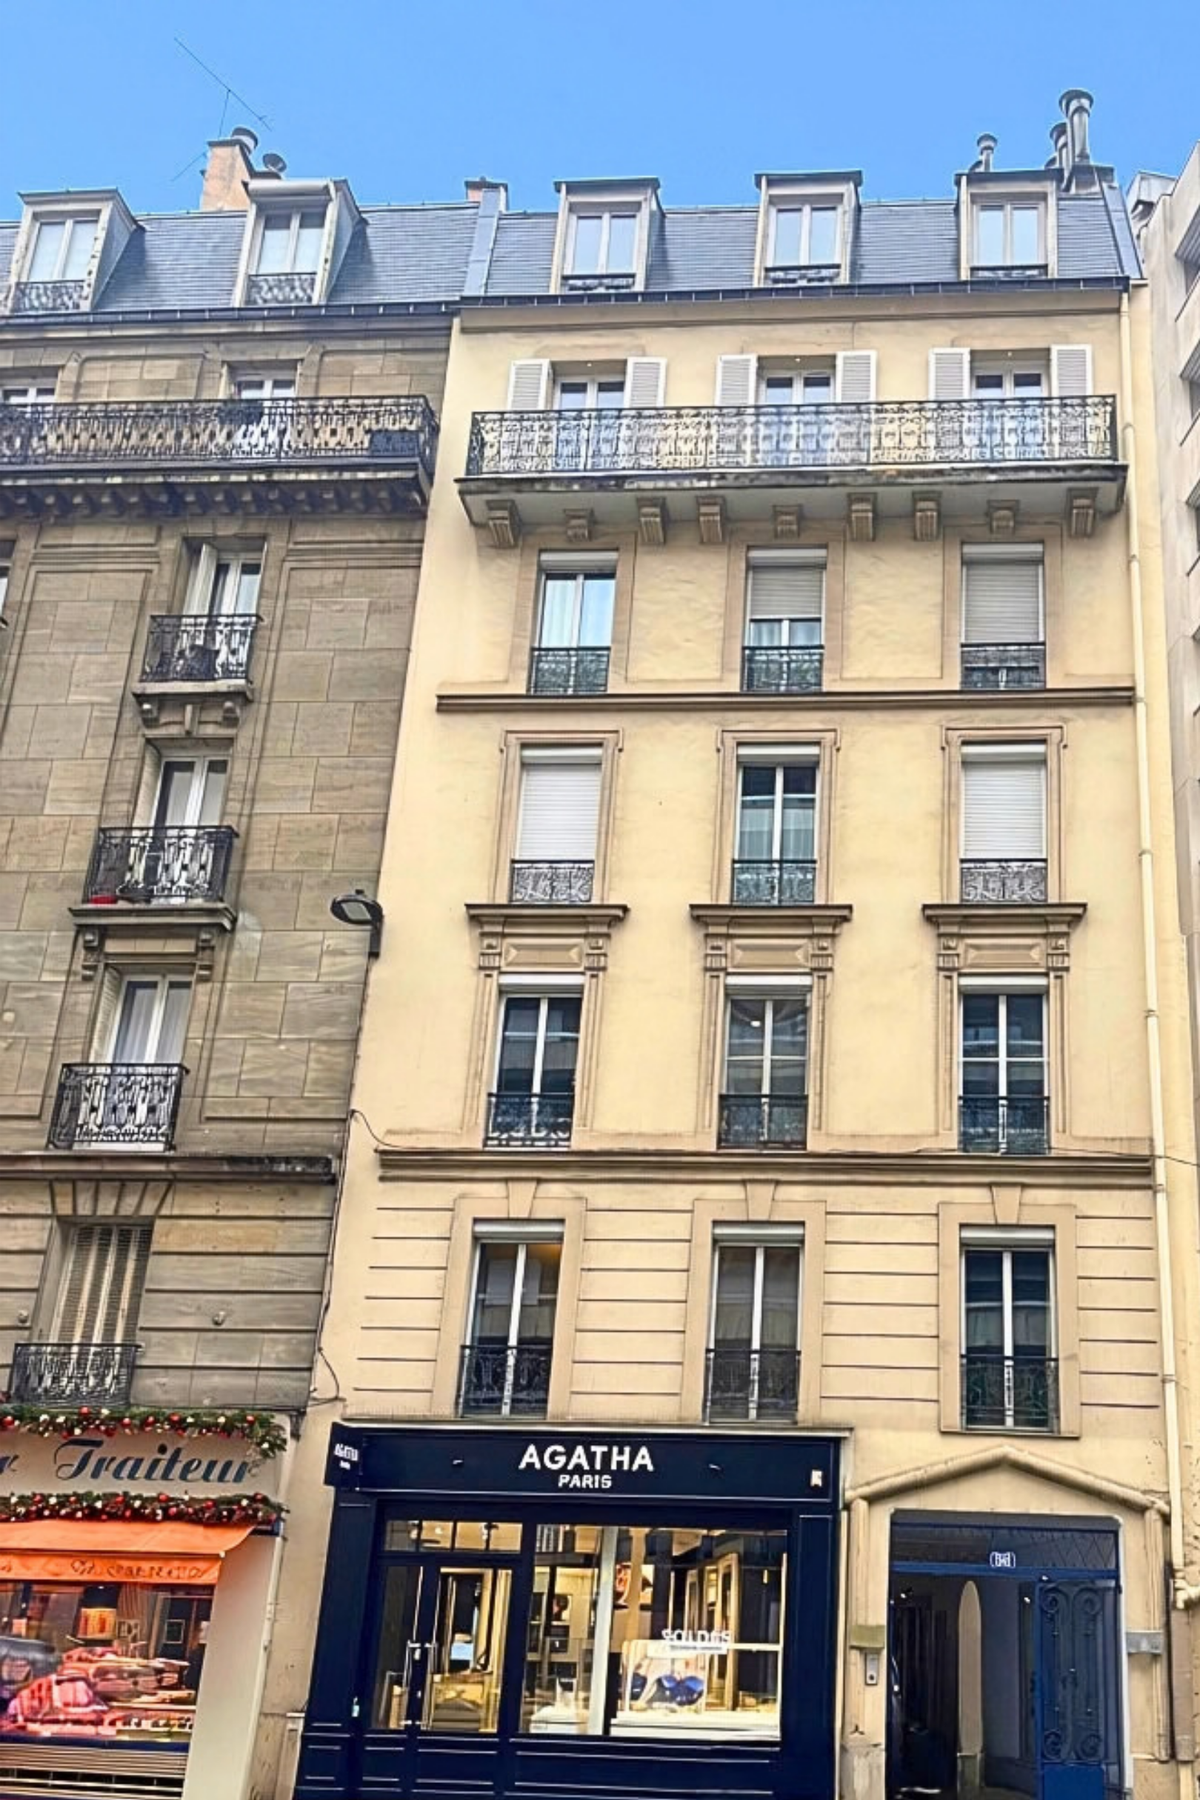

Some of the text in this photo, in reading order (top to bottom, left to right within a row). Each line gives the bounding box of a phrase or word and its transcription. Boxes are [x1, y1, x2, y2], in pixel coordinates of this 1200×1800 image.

[53, 1438, 262, 1484] Traiteur
[518, 1443, 655, 1472] AGATHA
[557, 1474, 613, 1489] PARIS
